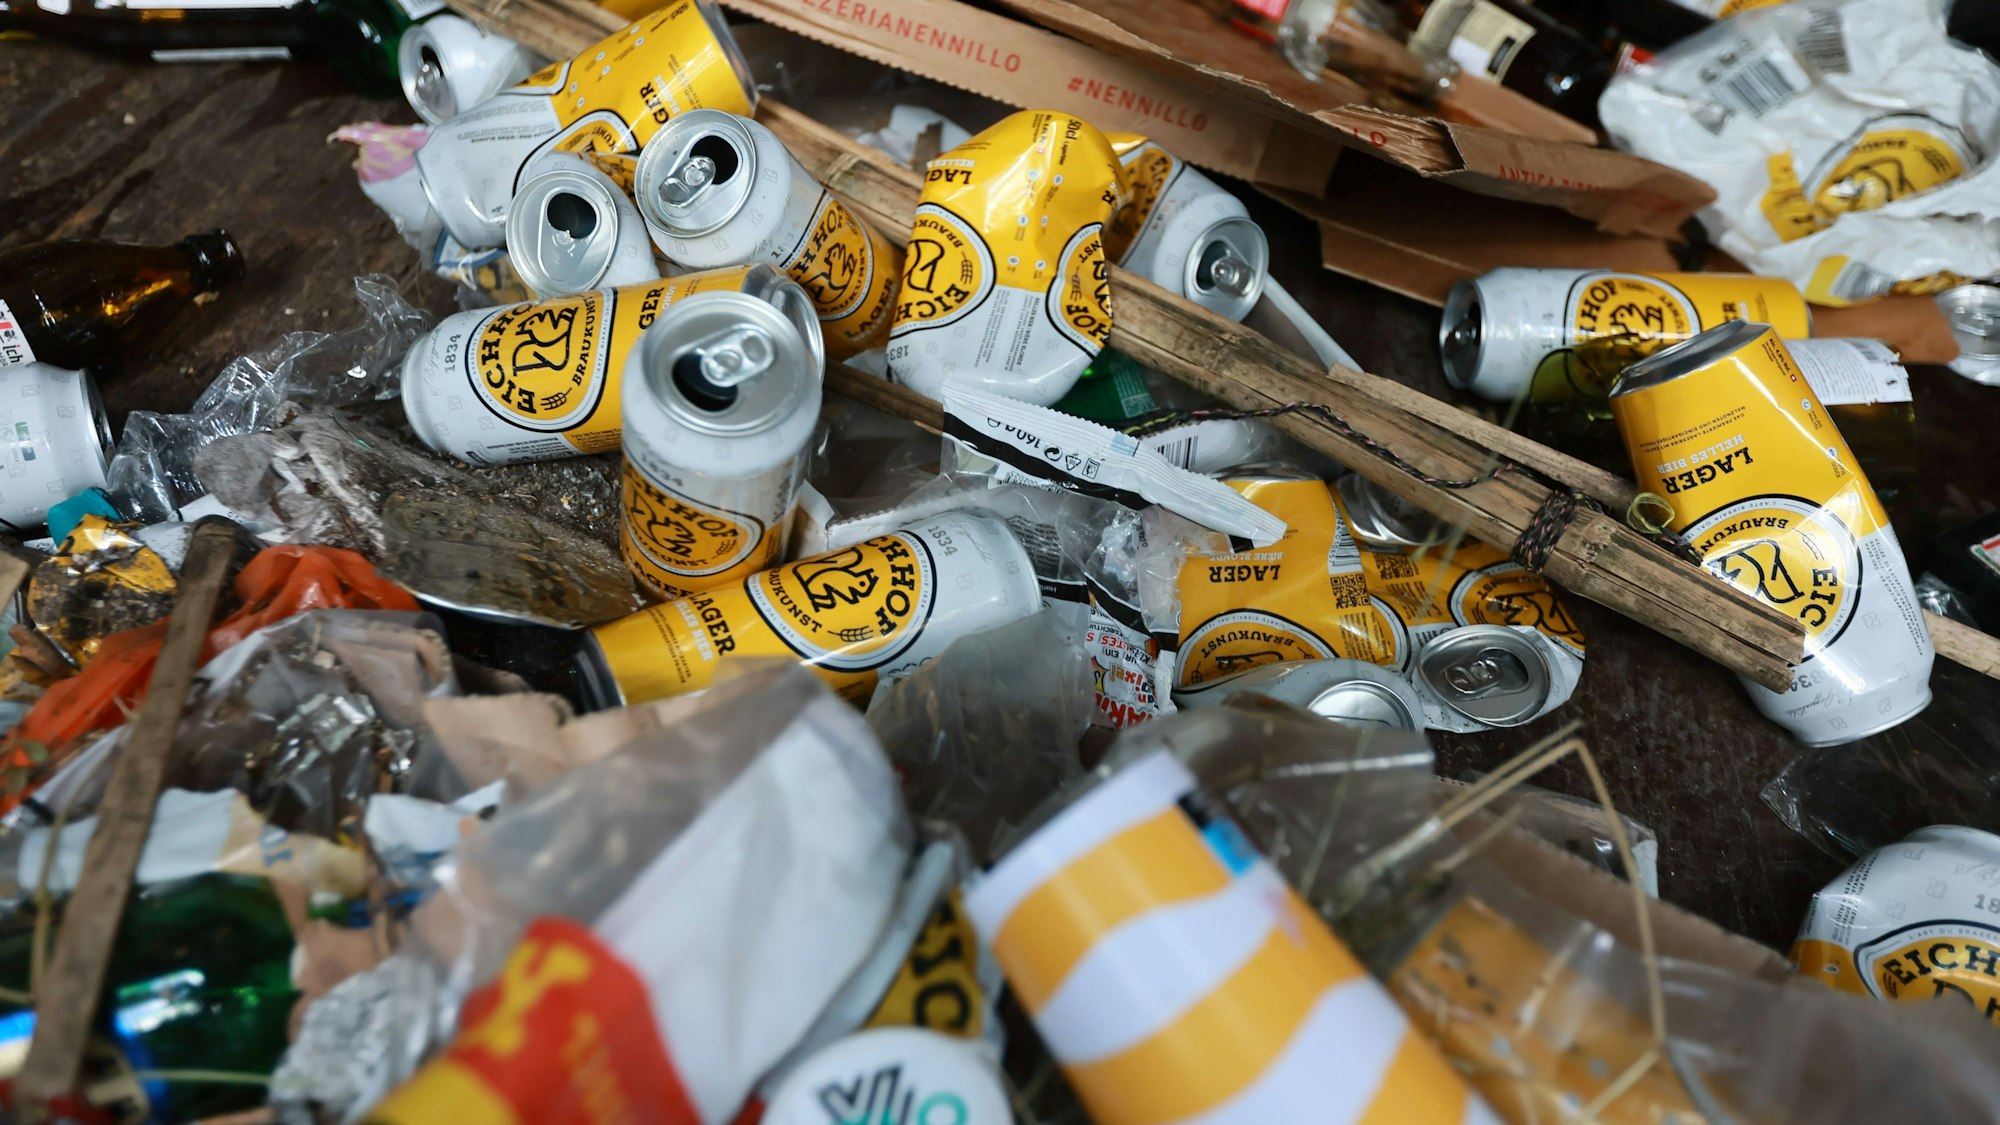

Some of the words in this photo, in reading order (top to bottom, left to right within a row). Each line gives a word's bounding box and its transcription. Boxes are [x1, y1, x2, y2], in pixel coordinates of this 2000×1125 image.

[1067, 75, 1208, 133] #NENNILLO
[924, 168, 973, 185] LAG
[444, 333, 461, 374] 1834
[1016, 429, 1040, 450] 160
[1690, 433, 1745, 464] HELLES
[1656, 456, 1689, 476] BIER
[1662, 446, 1754, 496] LAGER
[926, 525, 958, 558] 1834
[1699, 516, 1790, 557] BRAUKUN
[1209, 564, 1281, 583] LAGER
[1800, 566, 1839, 635] EIC
[689, 592, 736, 656] LAGER
[1200, 629, 1296, 659] BRAUKUNST
[1095, 692, 1153, 729] ARI
